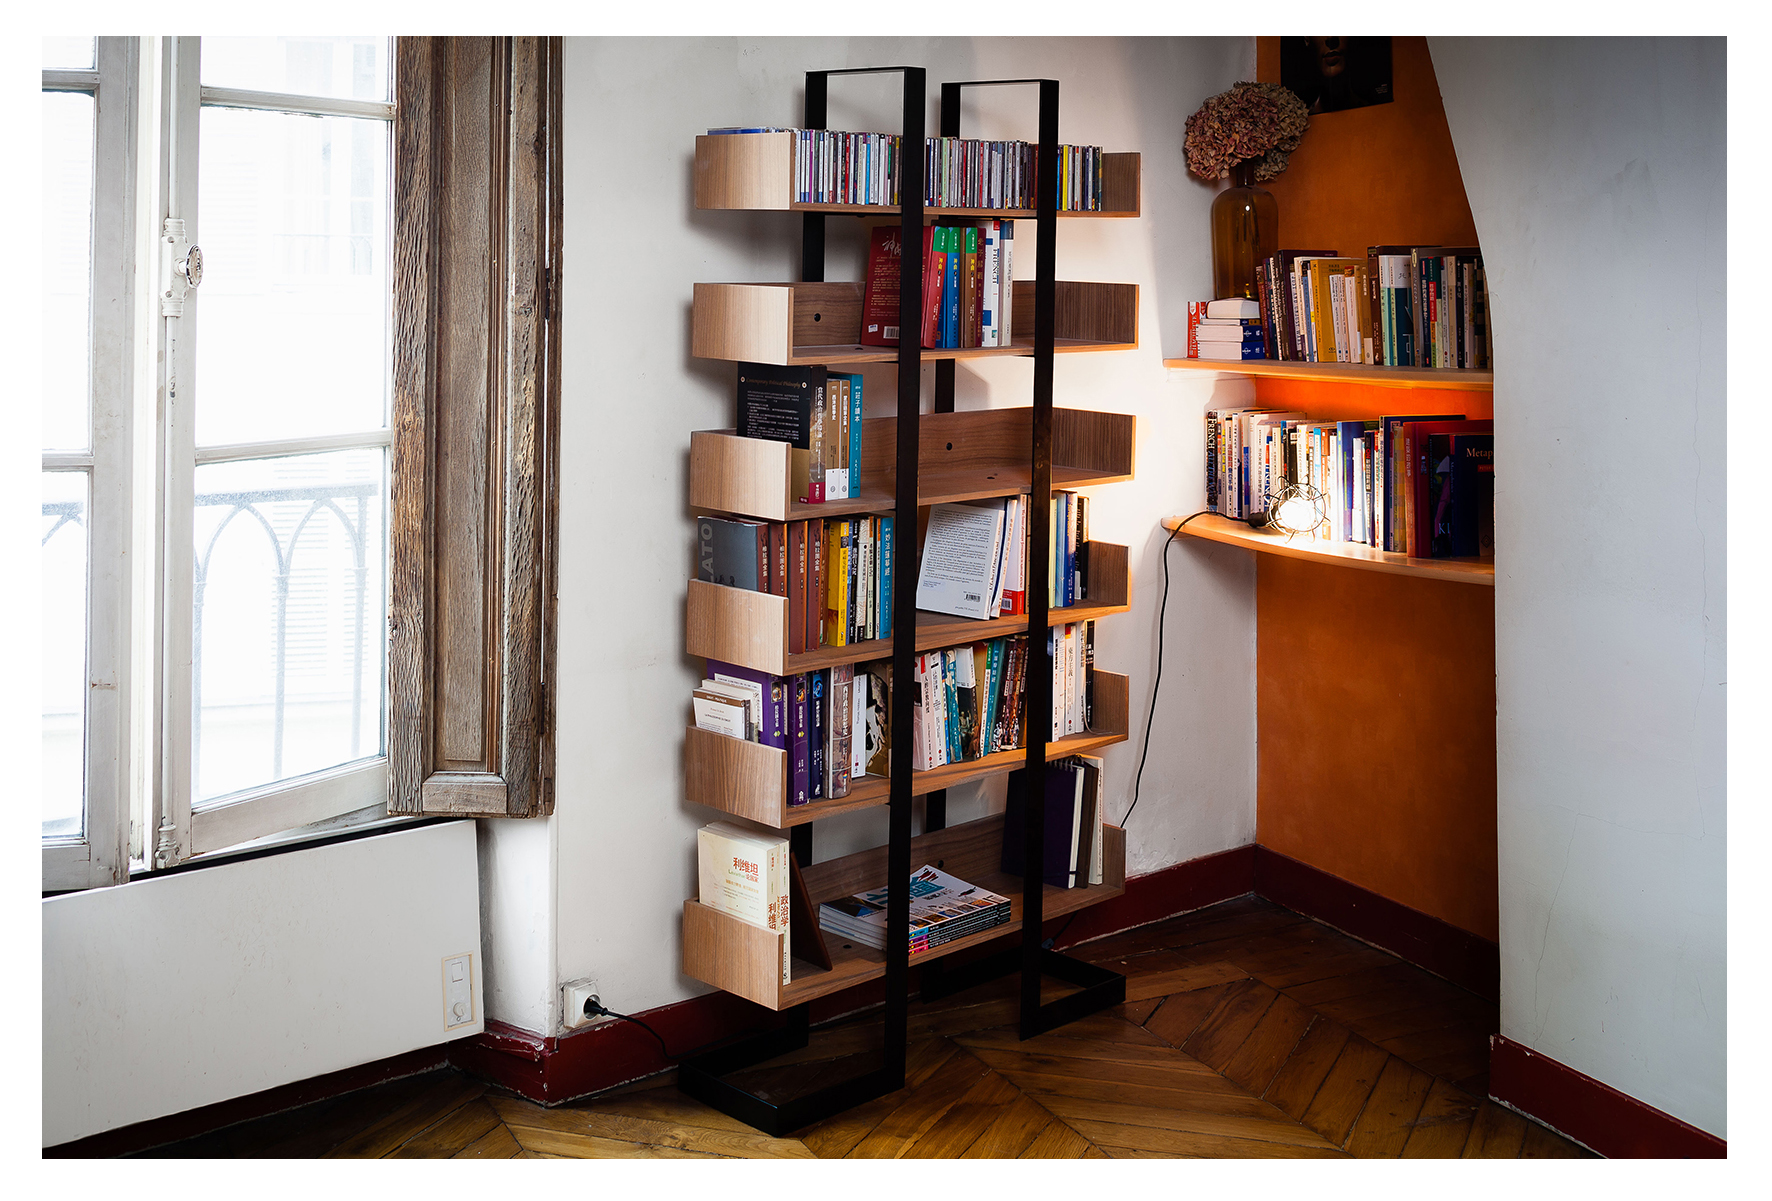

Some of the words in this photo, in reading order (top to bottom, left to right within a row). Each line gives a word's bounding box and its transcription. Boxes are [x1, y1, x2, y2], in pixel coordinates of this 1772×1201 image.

[1466, 448, 1494, 460] Metap
[732, 857, 759, 877] 利维坦
[780, 894, 789, 927] 政治学
